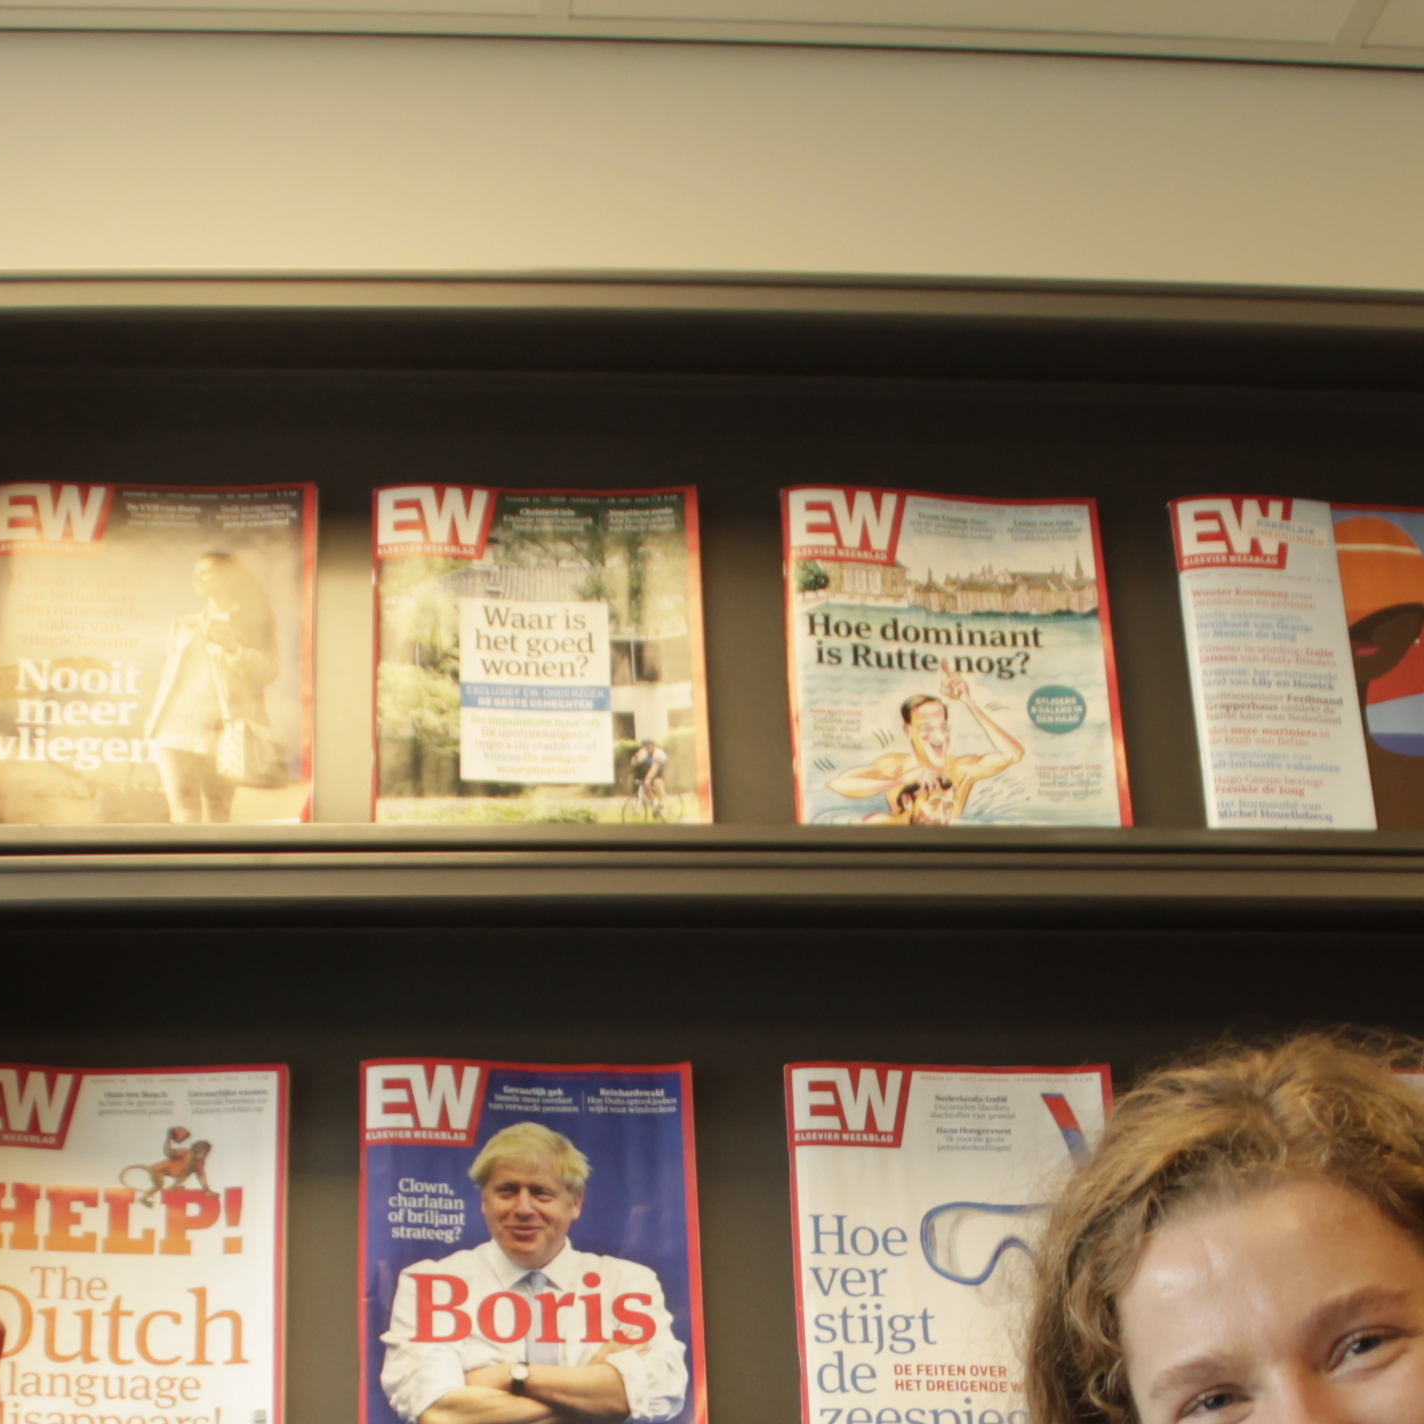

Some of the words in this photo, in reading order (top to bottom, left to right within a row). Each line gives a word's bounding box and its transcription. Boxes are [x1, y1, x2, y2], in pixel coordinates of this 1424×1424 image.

[378, 486, 488, 545] EW
[788, 488, 897, 550] EW
[1177, 498, 1284, 556] EW
[483, 606, 556, 630] Waar
[565, 609, 586, 629] is
[807, 613, 872, 638] Hoe
[880, 617, 1044, 649] dominant
[475, 630, 516, 652] het
[526, 632, 595, 656] goed
[816, 639, 842, 664] is
[851, 643, 938, 671] Rutte
[955, 650, 1030, 679] nog?
[15, 658, 140, 694] Nooit
[480, 656, 589, 678] wonen?
[16, 698, 137, 725] meer
[366, 1064, 480, 1130] EW
[792, 1067, 903, 1132] EW
[388, 1194, 465, 1210] charlatan
[398, 1178, 454, 1195] Clown,
[388, 1209, 405, 1223] of
[407, 1209, 465, 1226] briljant
[392, 1224, 461, 1242] strateeg?
[809, 1215, 907, 1256] Hoe
[30, 1266, 108, 1301] The
[809, 1267, 887, 1297] ver
[408, 1271, 657, 1345] Boris
[814, 1304, 937, 1355] stijgt
[8, 1361, 201, 1408] language
[817, 1351, 877, 1394] de
[894, 1365, 912, 1375] DE
[917, 1365, 965, 1376] FEITEN
[970, 1366, 1007, 1376] OVER
[895, 1380, 922, 1391] HET
[926, 1381, 1007, 1392] DREIGENDE
